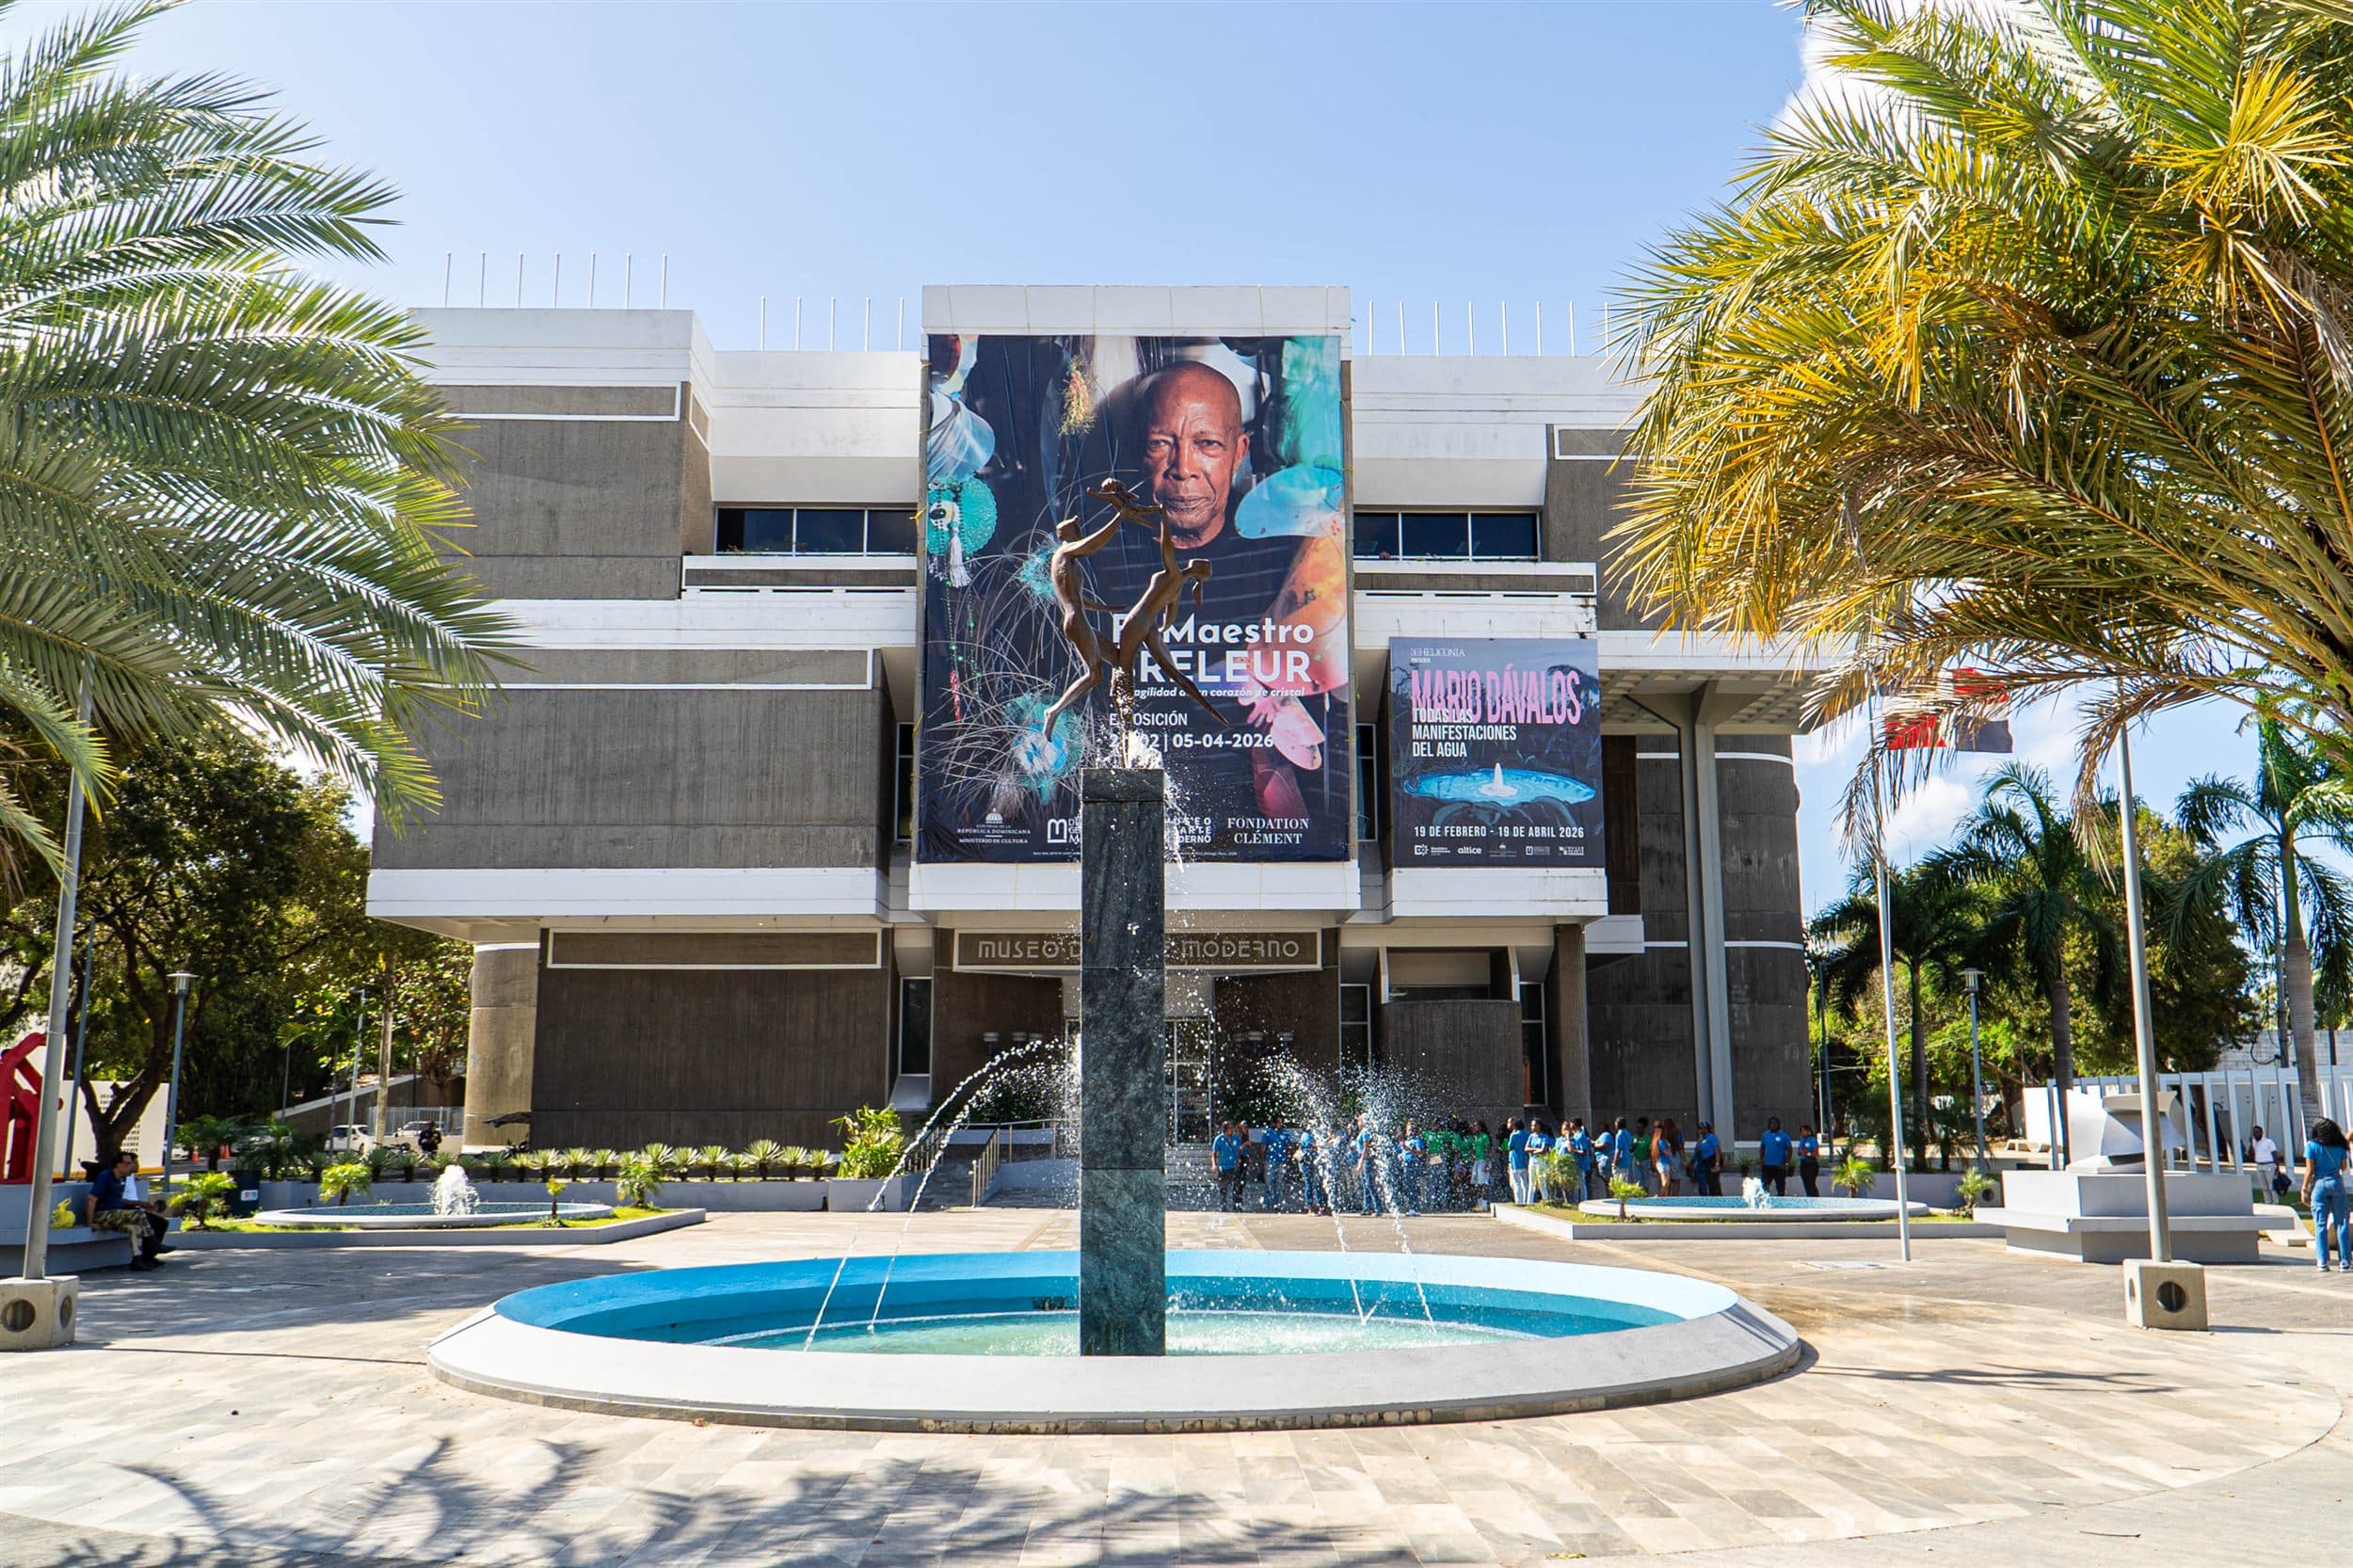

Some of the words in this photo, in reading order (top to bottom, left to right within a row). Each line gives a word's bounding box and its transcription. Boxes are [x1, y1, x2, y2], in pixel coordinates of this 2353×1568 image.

[1163, 612, 1314, 644] Maestro
[1133, 649, 1312, 682] RELEUR
[1134, 687, 1176, 699] agilidad
[1271, 687, 1305, 696] cristal
[1411, 669, 1482, 724] MARIO
[1486, 663, 1581, 725] DÁVALOS
[1110, 711, 1188, 726] EOSICIÓN
[1413, 708, 1449, 723] TODAS
[1453, 709, 1474, 723] LAS
[1413, 725, 1516, 740] MANIFESTACIONES
[1173, 733, 1273, 748] 05-04-2026
[1413, 742, 1433, 757] DEL
[1436, 742, 1467, 757] AGUA
[1227, 817, 1310, 829] FONDATION
[1234, 829, 1303, 844] CLÉMENT
[1414, 825, 1426, 837] 19
[1430, 825, 1441, 837] DE
[1445, 825, 1487, 837] FEBRERO
[1498, 825, 1510, 837] 19
[1513, 825, 1525, 837] DE
[1529, 826, 1556, 838] ABRIL
[1559, 826, 1584, 838] 2026
[1457, 845, 1482, 855] altice
[978, 940, 1060, 958] MUSEO
[1182, 940, 1300, 957] MODERNO
